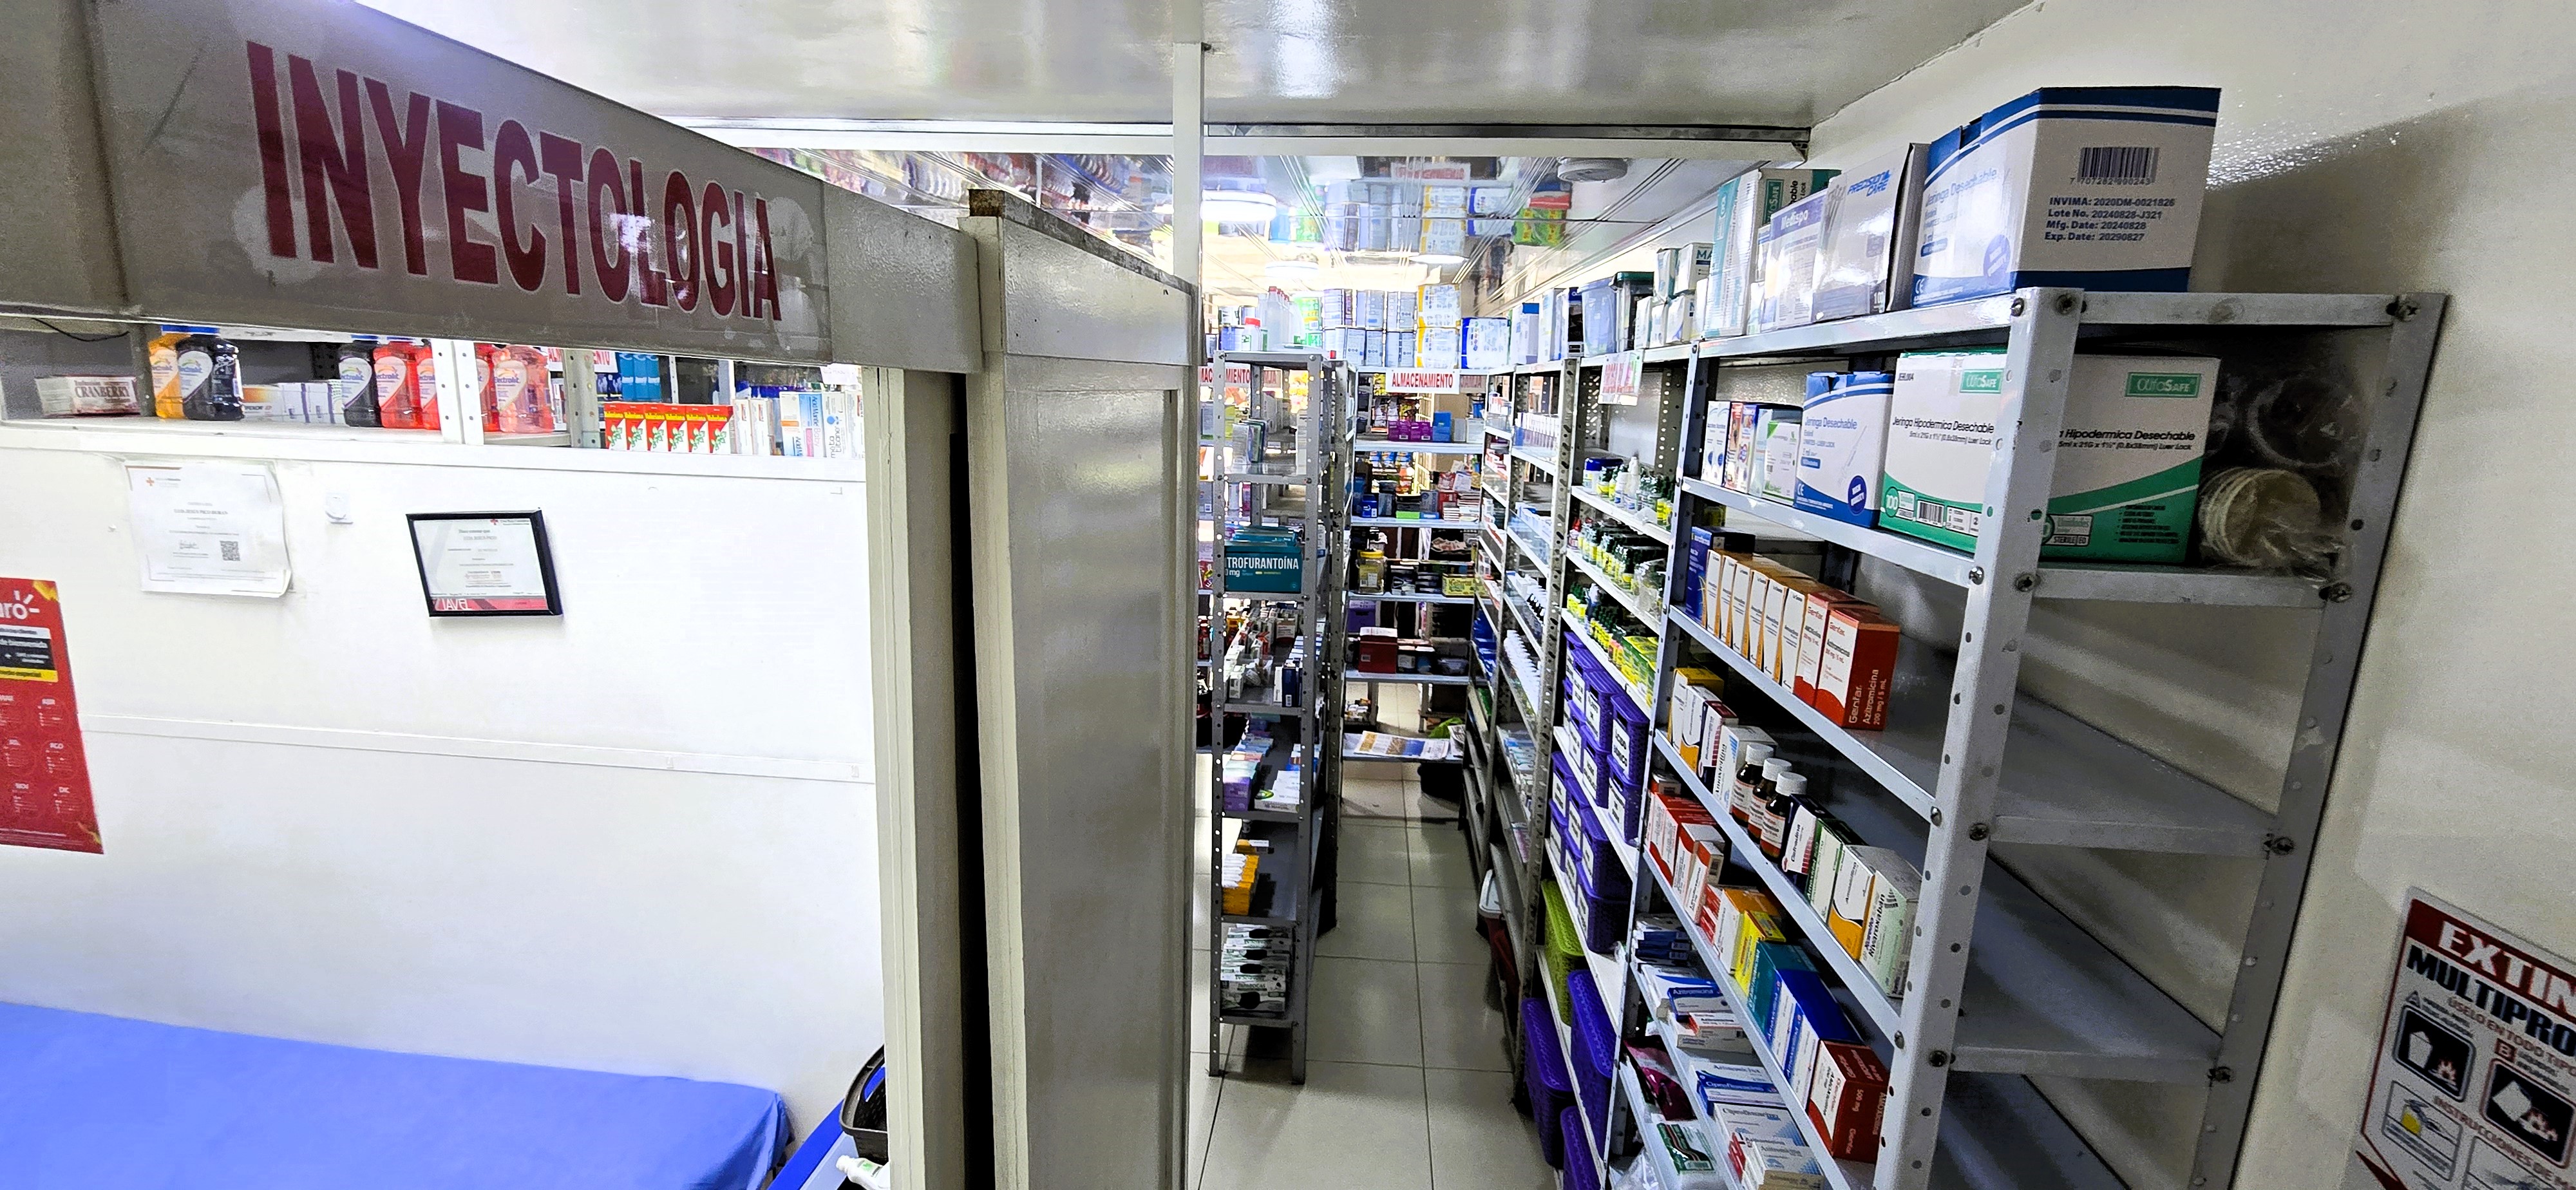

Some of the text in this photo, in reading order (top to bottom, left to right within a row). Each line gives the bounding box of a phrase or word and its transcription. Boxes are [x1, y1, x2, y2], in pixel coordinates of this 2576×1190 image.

[247, 41, 782, 321] INYECTOLOGIA
[2049, 197, 2092, 205] INVIMA:
[2048, 209, 2070, 218] Lote
[2072, 209, 2088, 218] No.
[2046, 220, 2069, 231] Mfg.
[2071, 221, 2098, 229] Date:
[2045, 232, 2067, 242] Exp.
[2068, 232, 2095, 241] Date:
[1392, 373, 1454, 388] ALMACENAMIENTO
[75, 386, 131, 398] CRANBERRY
[1823, 417, 1857, 430] Desechable
[1893, 417, 1994, 433] Jeringa Hipodermica Desechable
[2065, 429, 2195, 440] Hipodermica Desechable
[1862, 669, 1879, 724] Azitromicina
[1878, 701, 1883, 712] mg
[2506, 1030, 2544, 1057] TODO
